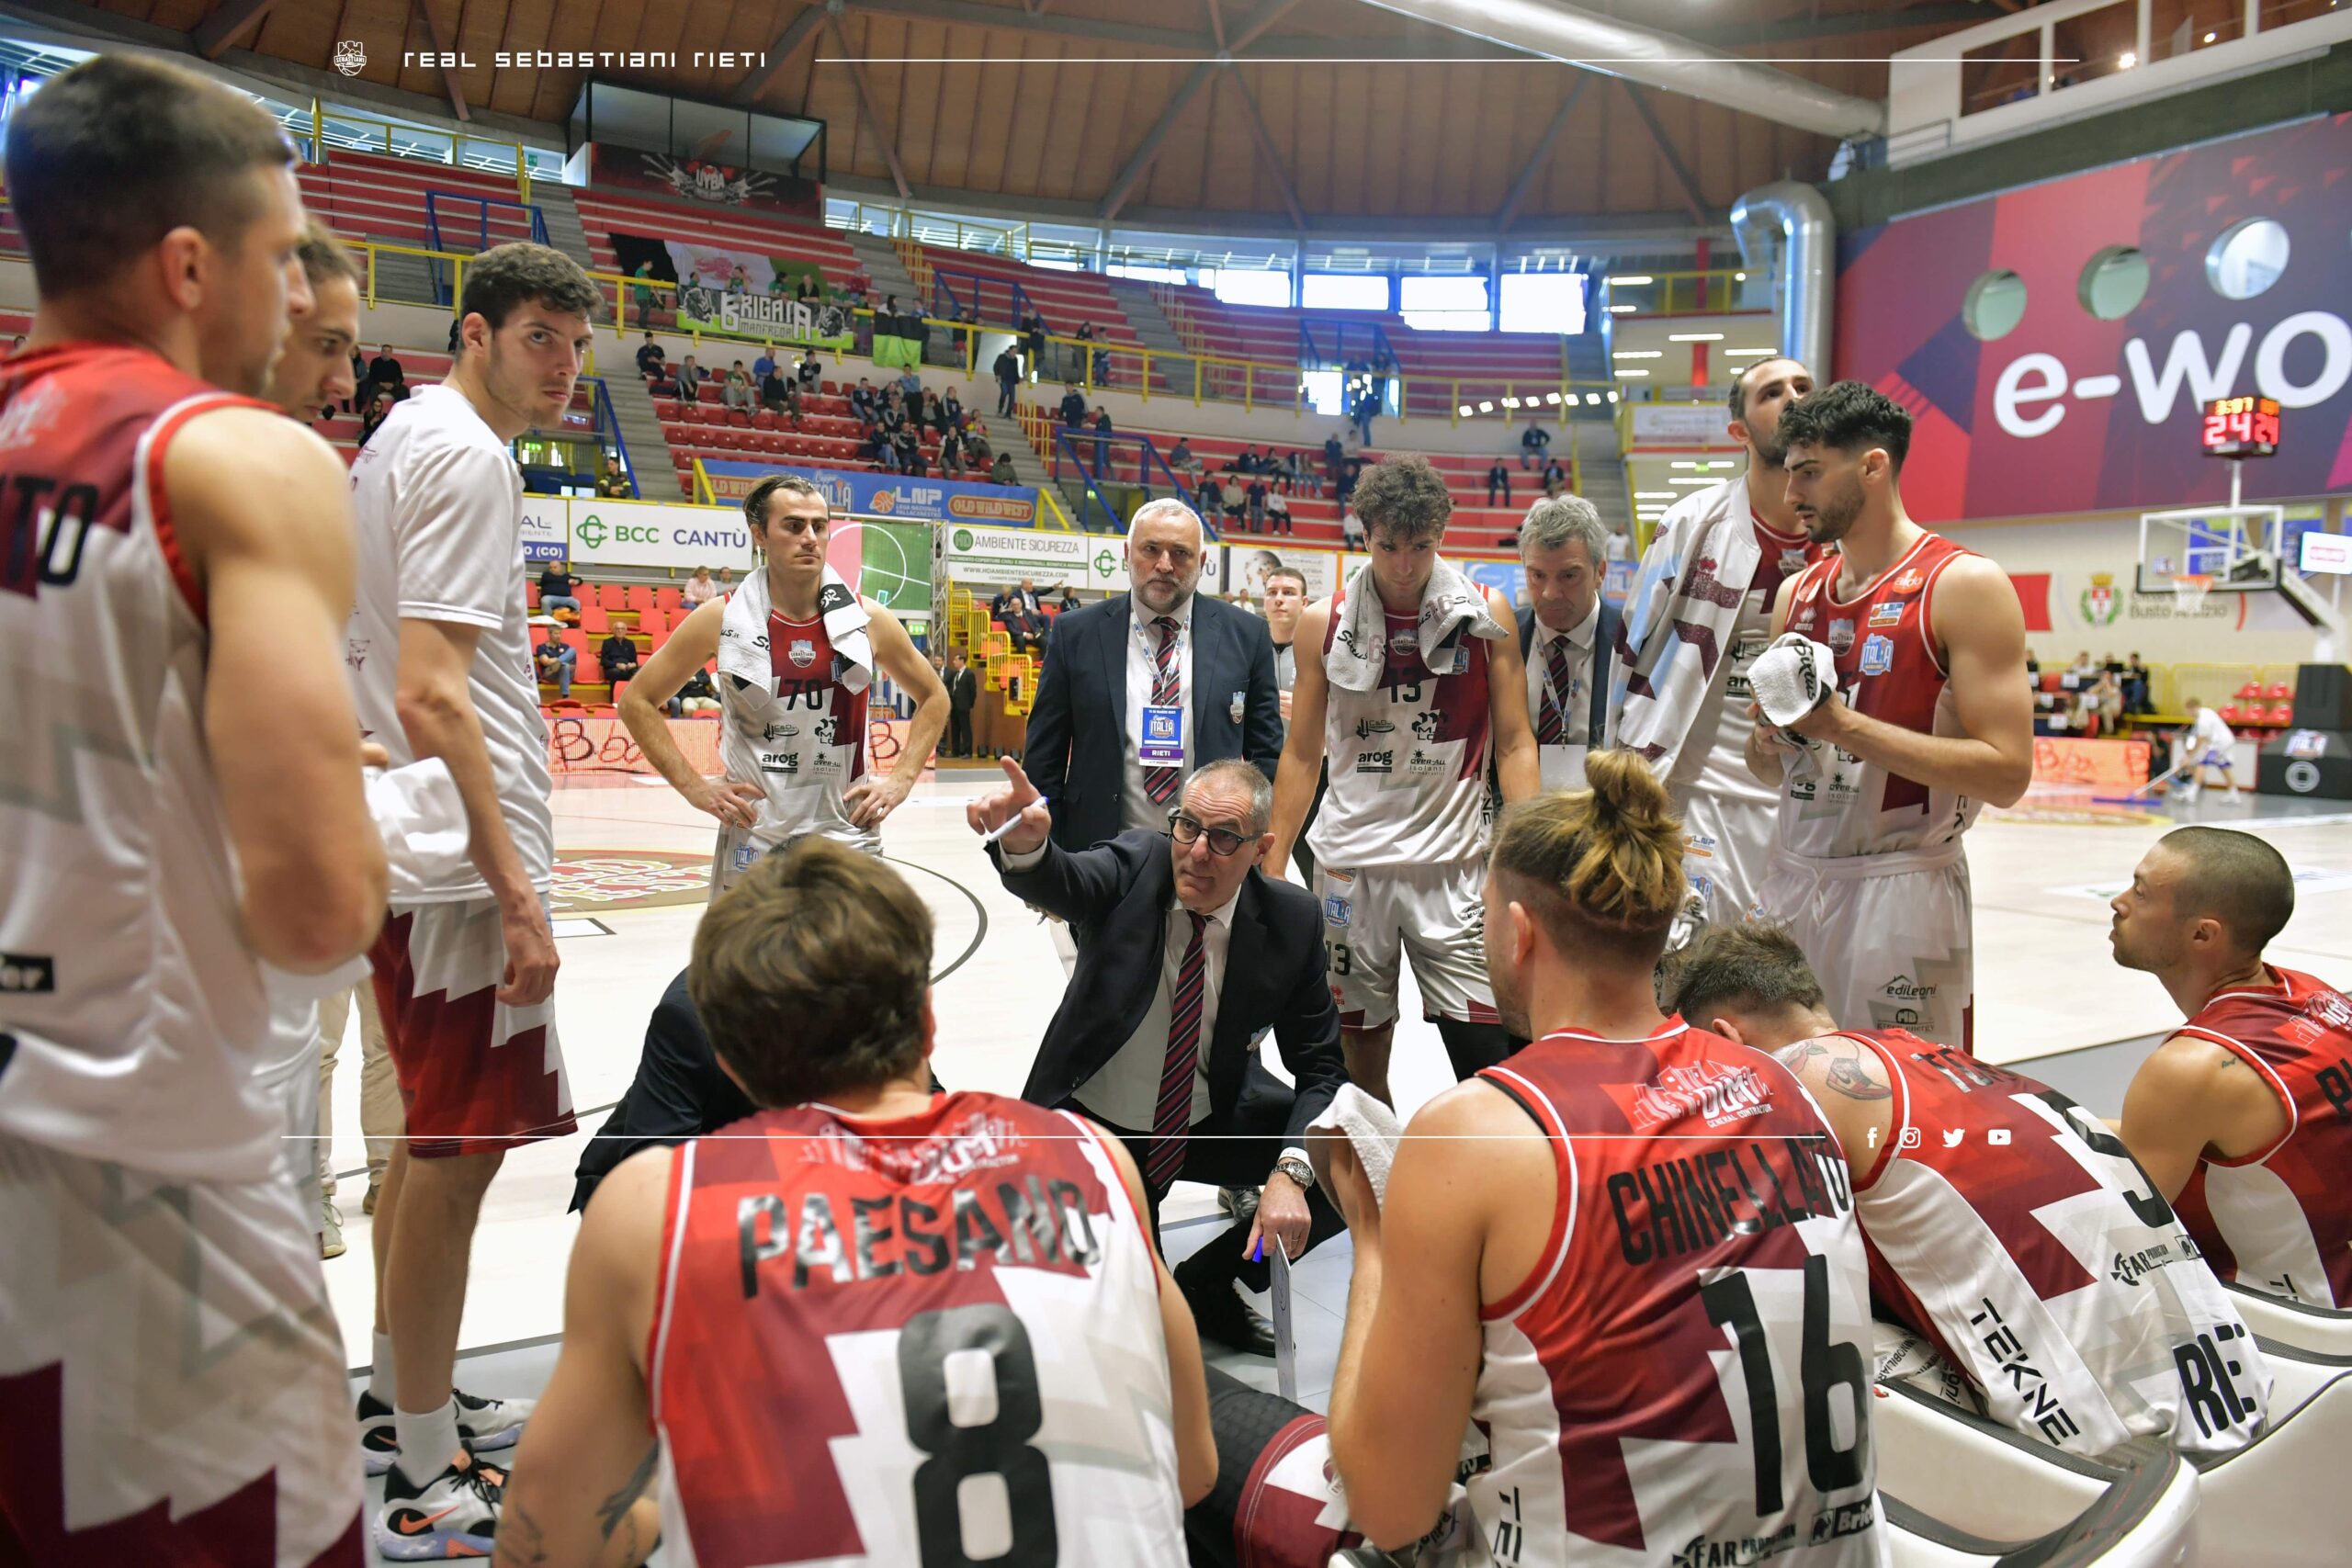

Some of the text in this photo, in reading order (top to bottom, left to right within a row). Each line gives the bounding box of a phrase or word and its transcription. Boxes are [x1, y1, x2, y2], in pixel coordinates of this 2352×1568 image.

[720, 291, 811, 341] BRIGATA
[2204, 412, 2253, 446] 24
[895, 485, 943, 505] LNP
[954, 499, 1030, 518] OLD WILD WEST
[615, 525, 746, 548] BCC CANTÙ
[955, 534, 1080, 554] HD AMBIENTE SICUREZZA
[536, 546, 563, 559] (CO)
[784, 678, 823, 711] 70
[1386, 668, 1421, 704] 13
[762, 751, 799, 767] arog
[1358, 750, 1394, 766] arog
[1693, 835, 1715, 846] LNP
[1325, 939, 1351, 976] 13
[1886, 983, 1938, 997] edileoni
[1705, 1102, 1774, 1129] GENERAL CONTRACTOR
[1608, 1132, 1851, 1267] CHINELLATO
[737, 1175, 1102, 1300] PAESANO
[2120, 1251, 2152, 1280] FAR
[1699, 1253, 1876, 1518] 16
[1969, 1297, 2080, 1448] TEKNE
[897, 1303, 1059, 1568] 8
